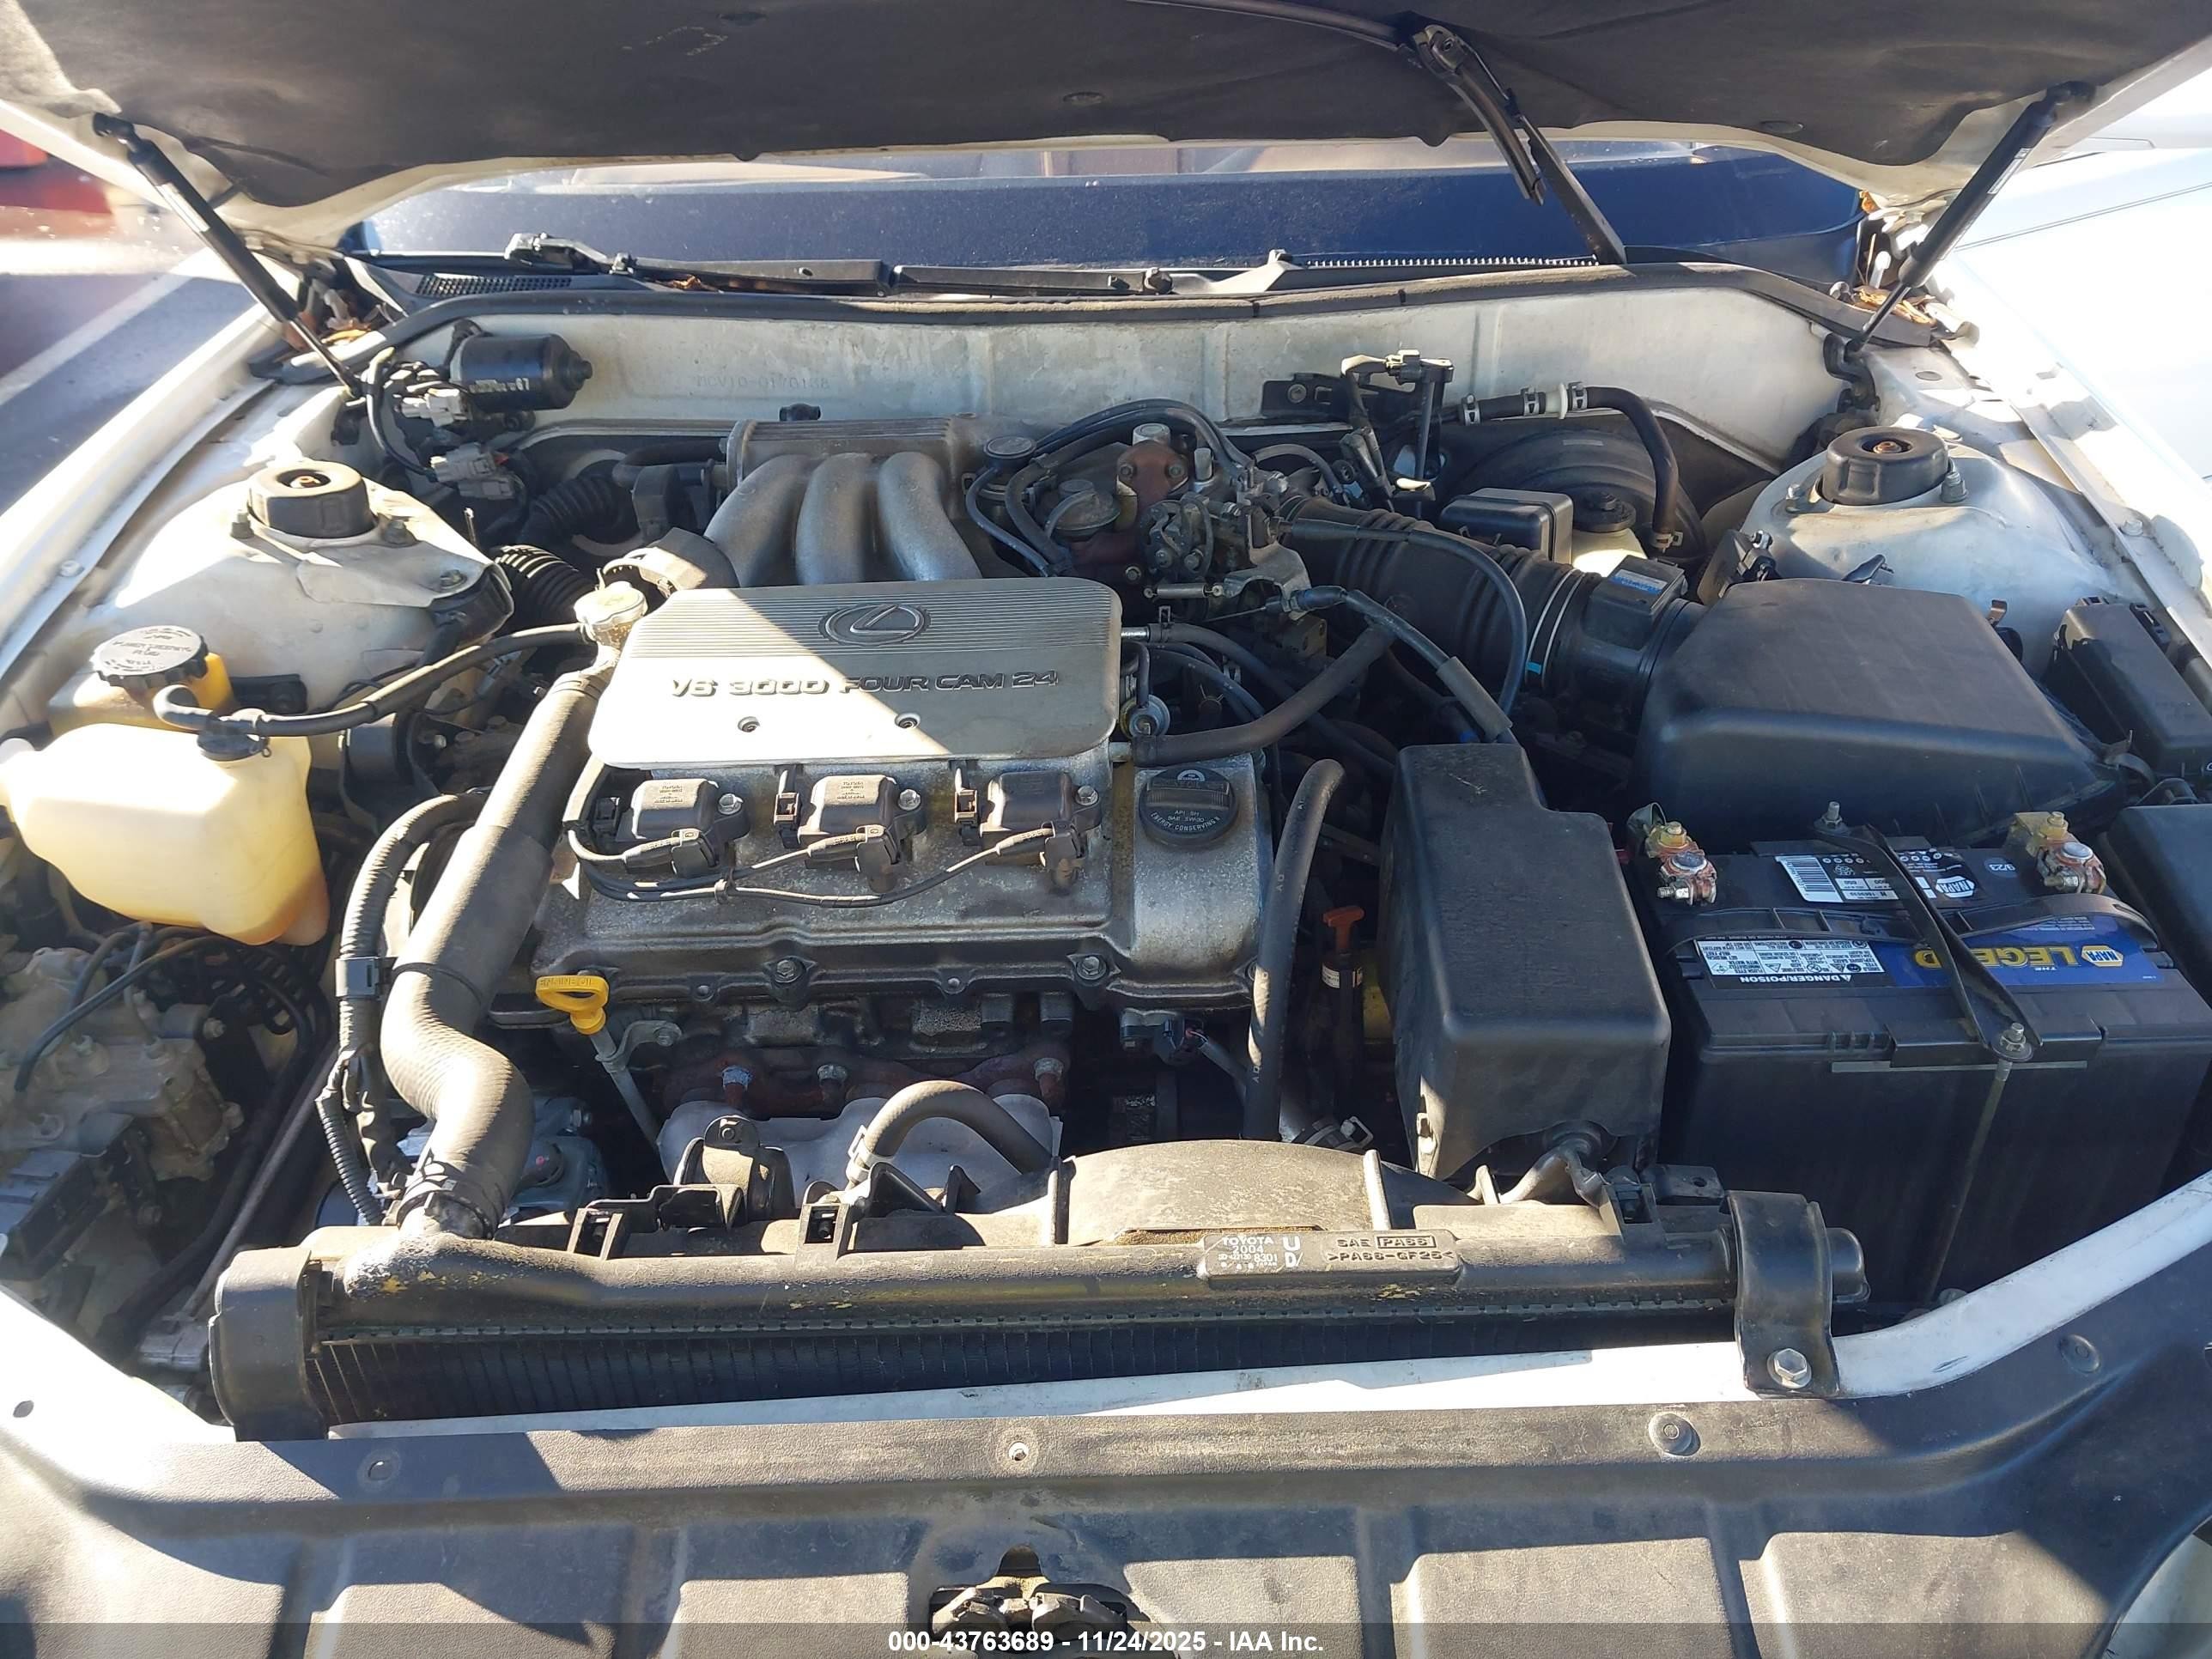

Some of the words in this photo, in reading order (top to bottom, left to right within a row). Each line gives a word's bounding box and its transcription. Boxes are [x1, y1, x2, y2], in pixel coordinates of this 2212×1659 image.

[672, 678, 719, 697] V6
[728, 678, 830, 696] 3000
[839, 676, 929, 693] FOUR
[935, 672, 1006, 690] CAM
[1012, 670, 1059, 688] 24
[1151, 812, 1175, 828] ENERGY
[1175, 818, 1217, 831] CONSERVING
[1939, 880, 1971, 893] NAPA
[1915, 946, 2082, 969] LEGED
[2086, 951, 2118, 962] NAPA
[1222, 1235, 1274, 1245] TOYOTA
[1282, 1237, 1301, 1251] U
[1337, 1238, 1371, 1248] SAE
[1232, 1245, 1264, 1255] 2004
[1254, 1253, 1279, 1262] 8301
